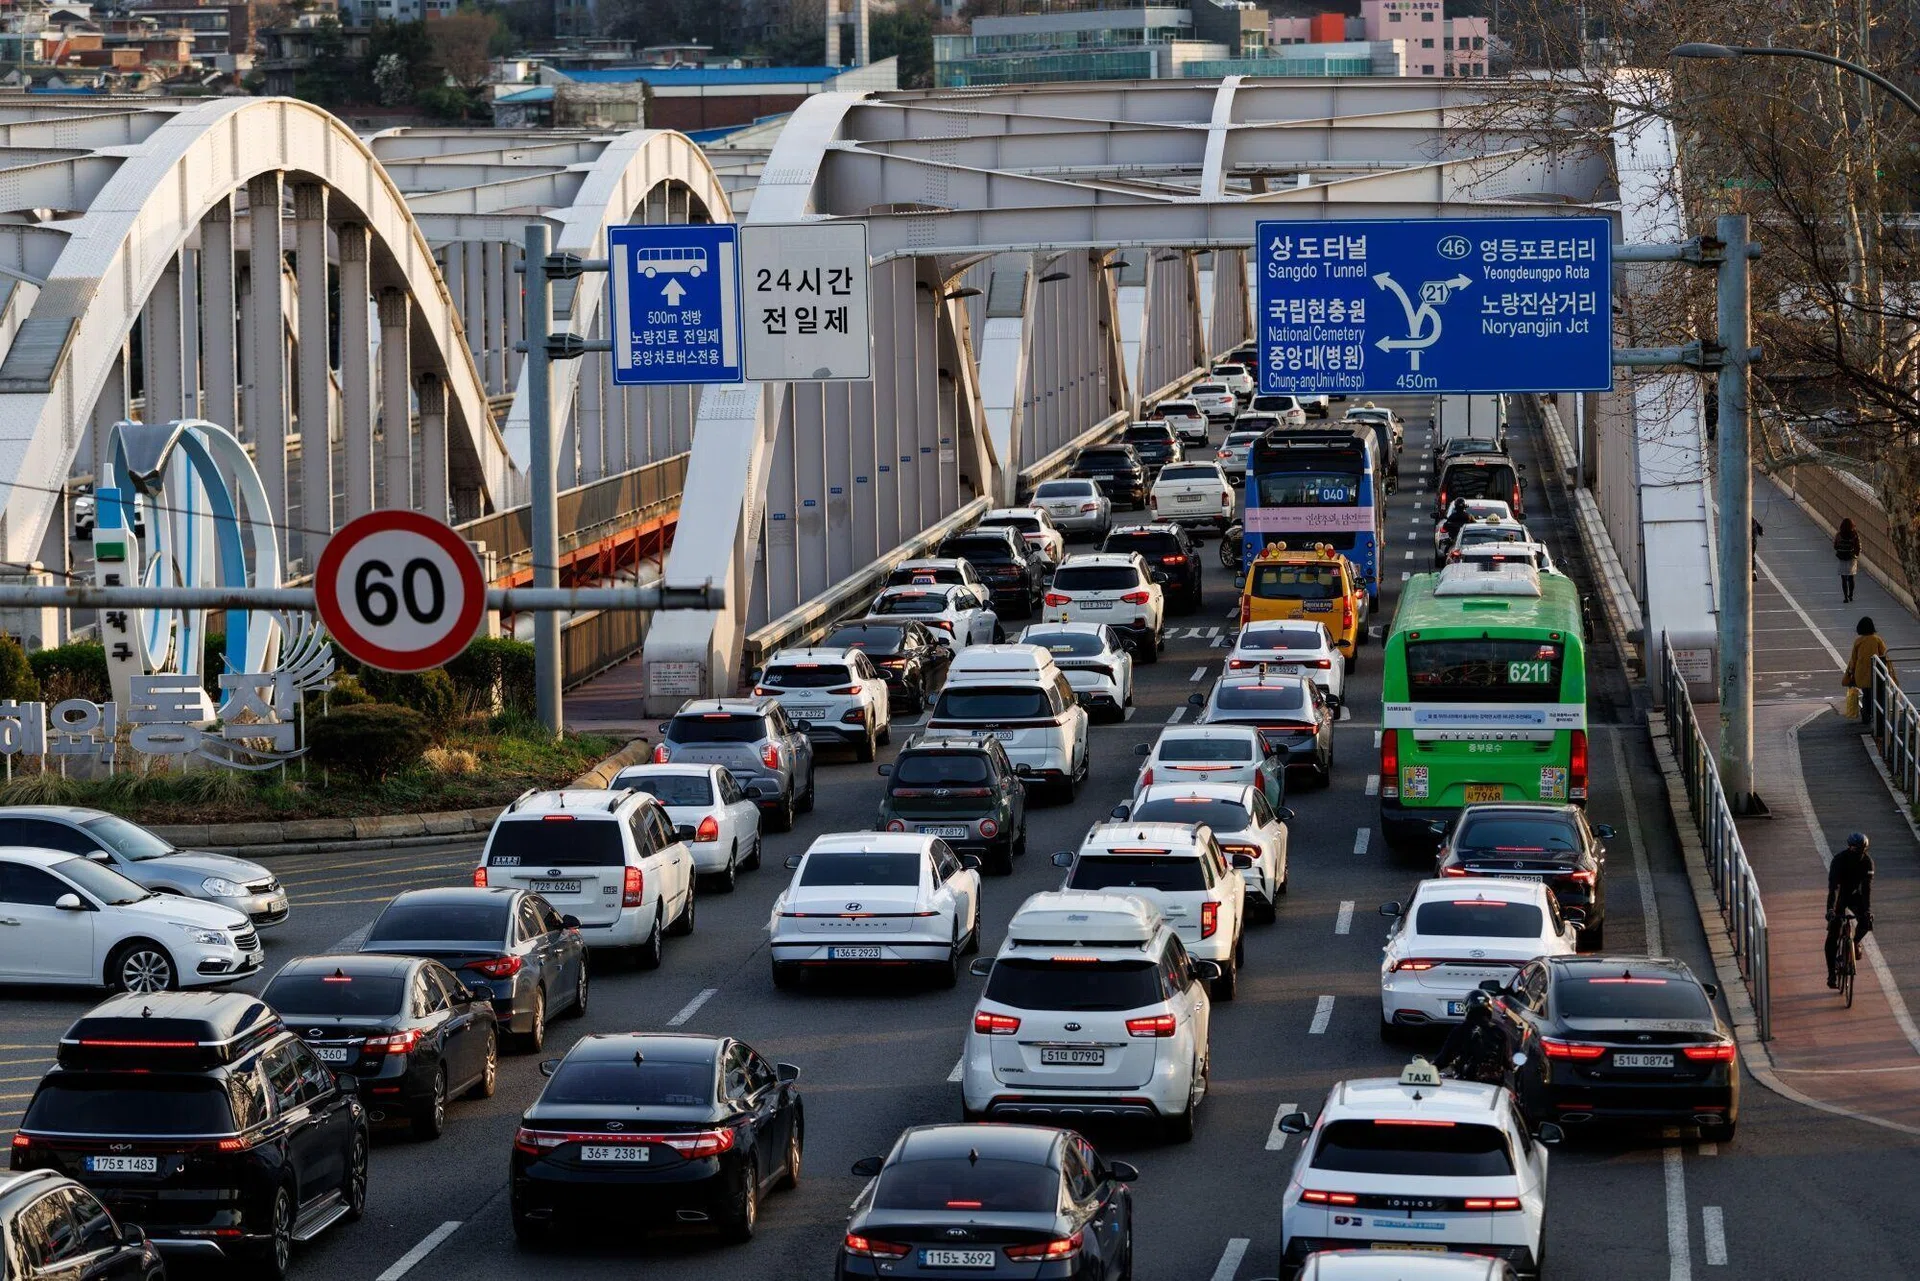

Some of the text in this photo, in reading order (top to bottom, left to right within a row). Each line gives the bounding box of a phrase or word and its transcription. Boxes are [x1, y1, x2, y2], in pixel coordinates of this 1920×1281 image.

[1268, 235, 1367, 261] 상도터널
[1442, 240, 1465, 256] 46
[1479, 238, 1597, 262] 영등포로터리
[1268, 262, 1367, 279] Sangdo Tunnel
[1483, 265, 1590, 283] Yeongdeungpo Rota
[757, 267, 853, 295] 24시간
[1425, 285, 1445, 303] 21
[1268, 298, 1366, 324] 국립현충원
[1481, 291, 1597, 316] 노량진삼거리
[647, 310, 702, 325] 500m 전방
[762, 307, 848, 335] 전일제
[1268, 326, 1366, 345] National Cemetery
[1482, 318, 1589, 338] Noryangjin Jct
[631, 328, 720, 345] 노량진로 전일제
[631, 349, 720, 366] 중앙차로버스전용
[1268, 345, 1365, 371] 중앙대(병원)
[1396, 375, 1438, 389] 450m
[1322, 487, 1344, 501] 040
[355, 557, 445, 627] 60
[1509, 660, 1551, 684] 6211
[126, 673, 301, 753] 동작
[1440, 731, 1529, 740] HYUNDAI
[1468, 744, 1501, 753] 중부운수
[1415, 768, 1428, 779] 주의
[1542, 768, 1554, 779] 주의
[944, 828, 962, 836] 6812
[554, 881, 576, 891] 6246
[858, 947, 879, 958] 2923
[1071, 1052, 1098, 1063] 0790
[1643, 1057, 1669, 1066] 0874
[1407, 1073, 1432, 1083] TAXI
[587, 1148, 643, 1160] 36주 2381
[95, 1158, 154, 1171] 175호 1483
[929, 1253, 991, 1265] 115노 3692
